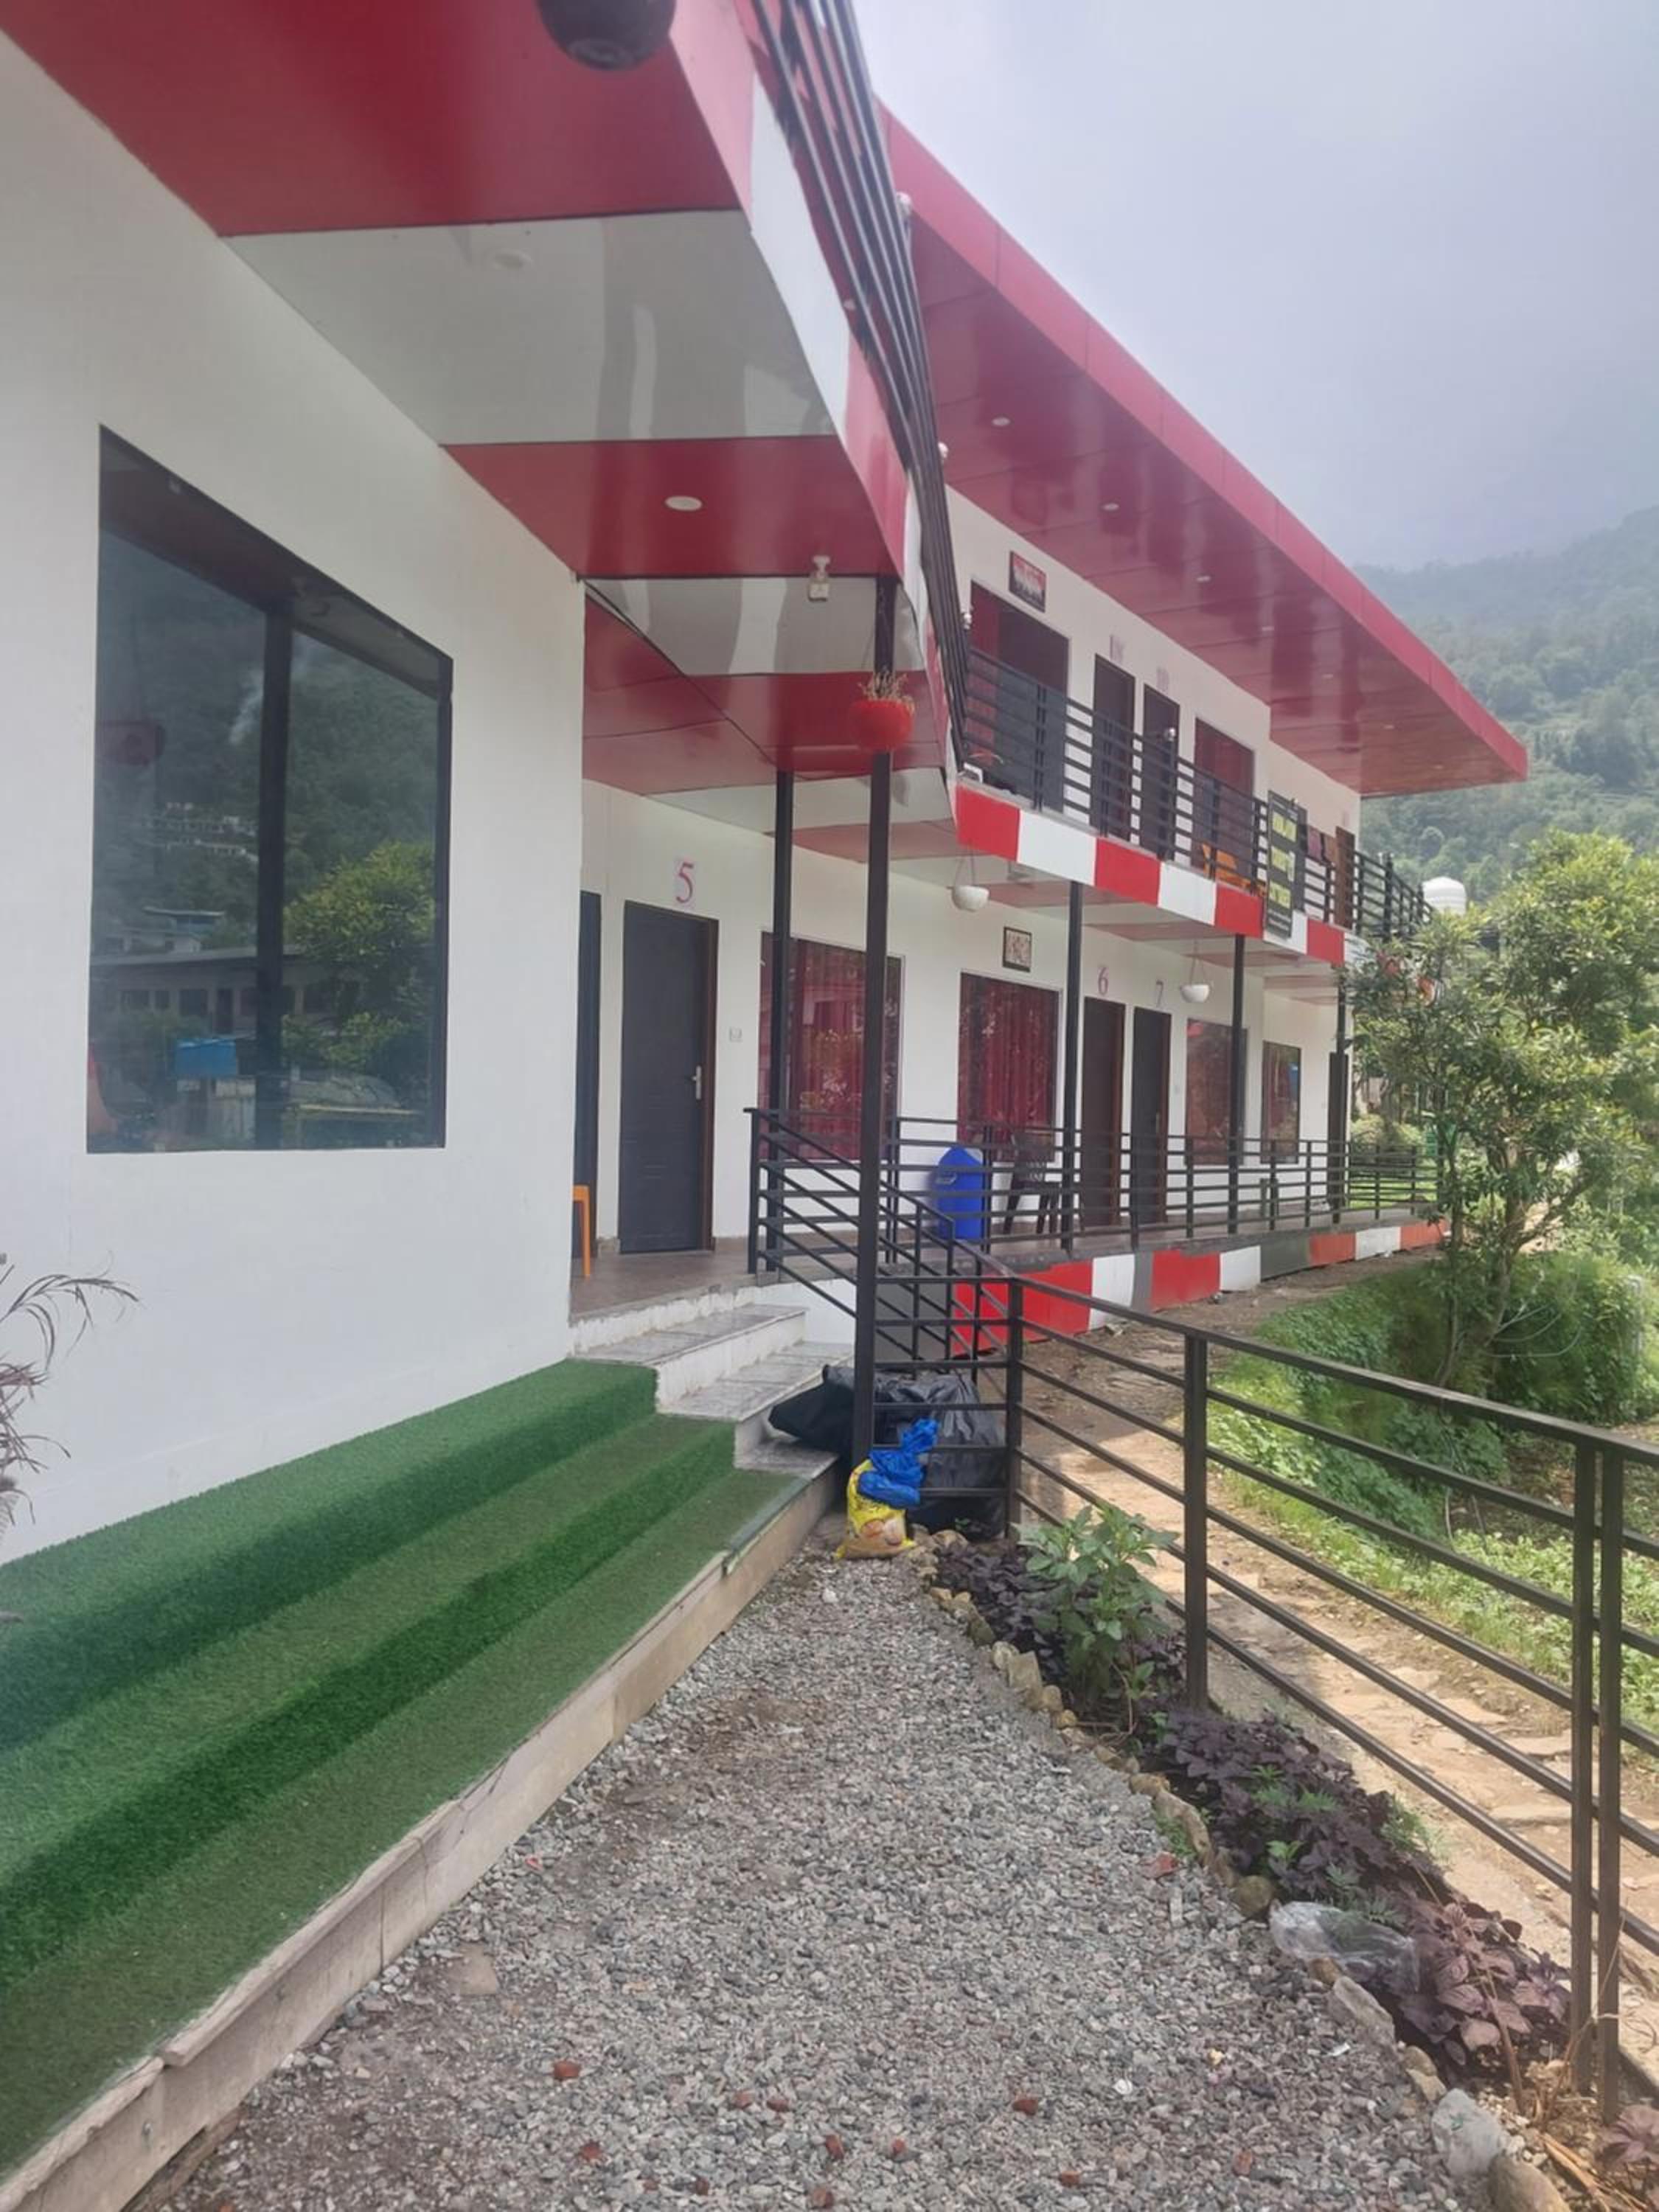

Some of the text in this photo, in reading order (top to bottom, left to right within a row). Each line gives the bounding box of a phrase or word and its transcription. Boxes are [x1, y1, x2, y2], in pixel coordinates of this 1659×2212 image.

[675, 860, 694, 904] 5
[1097, 965, 1109, 996] 6
[1155, 979, 1164, 1007] 7
